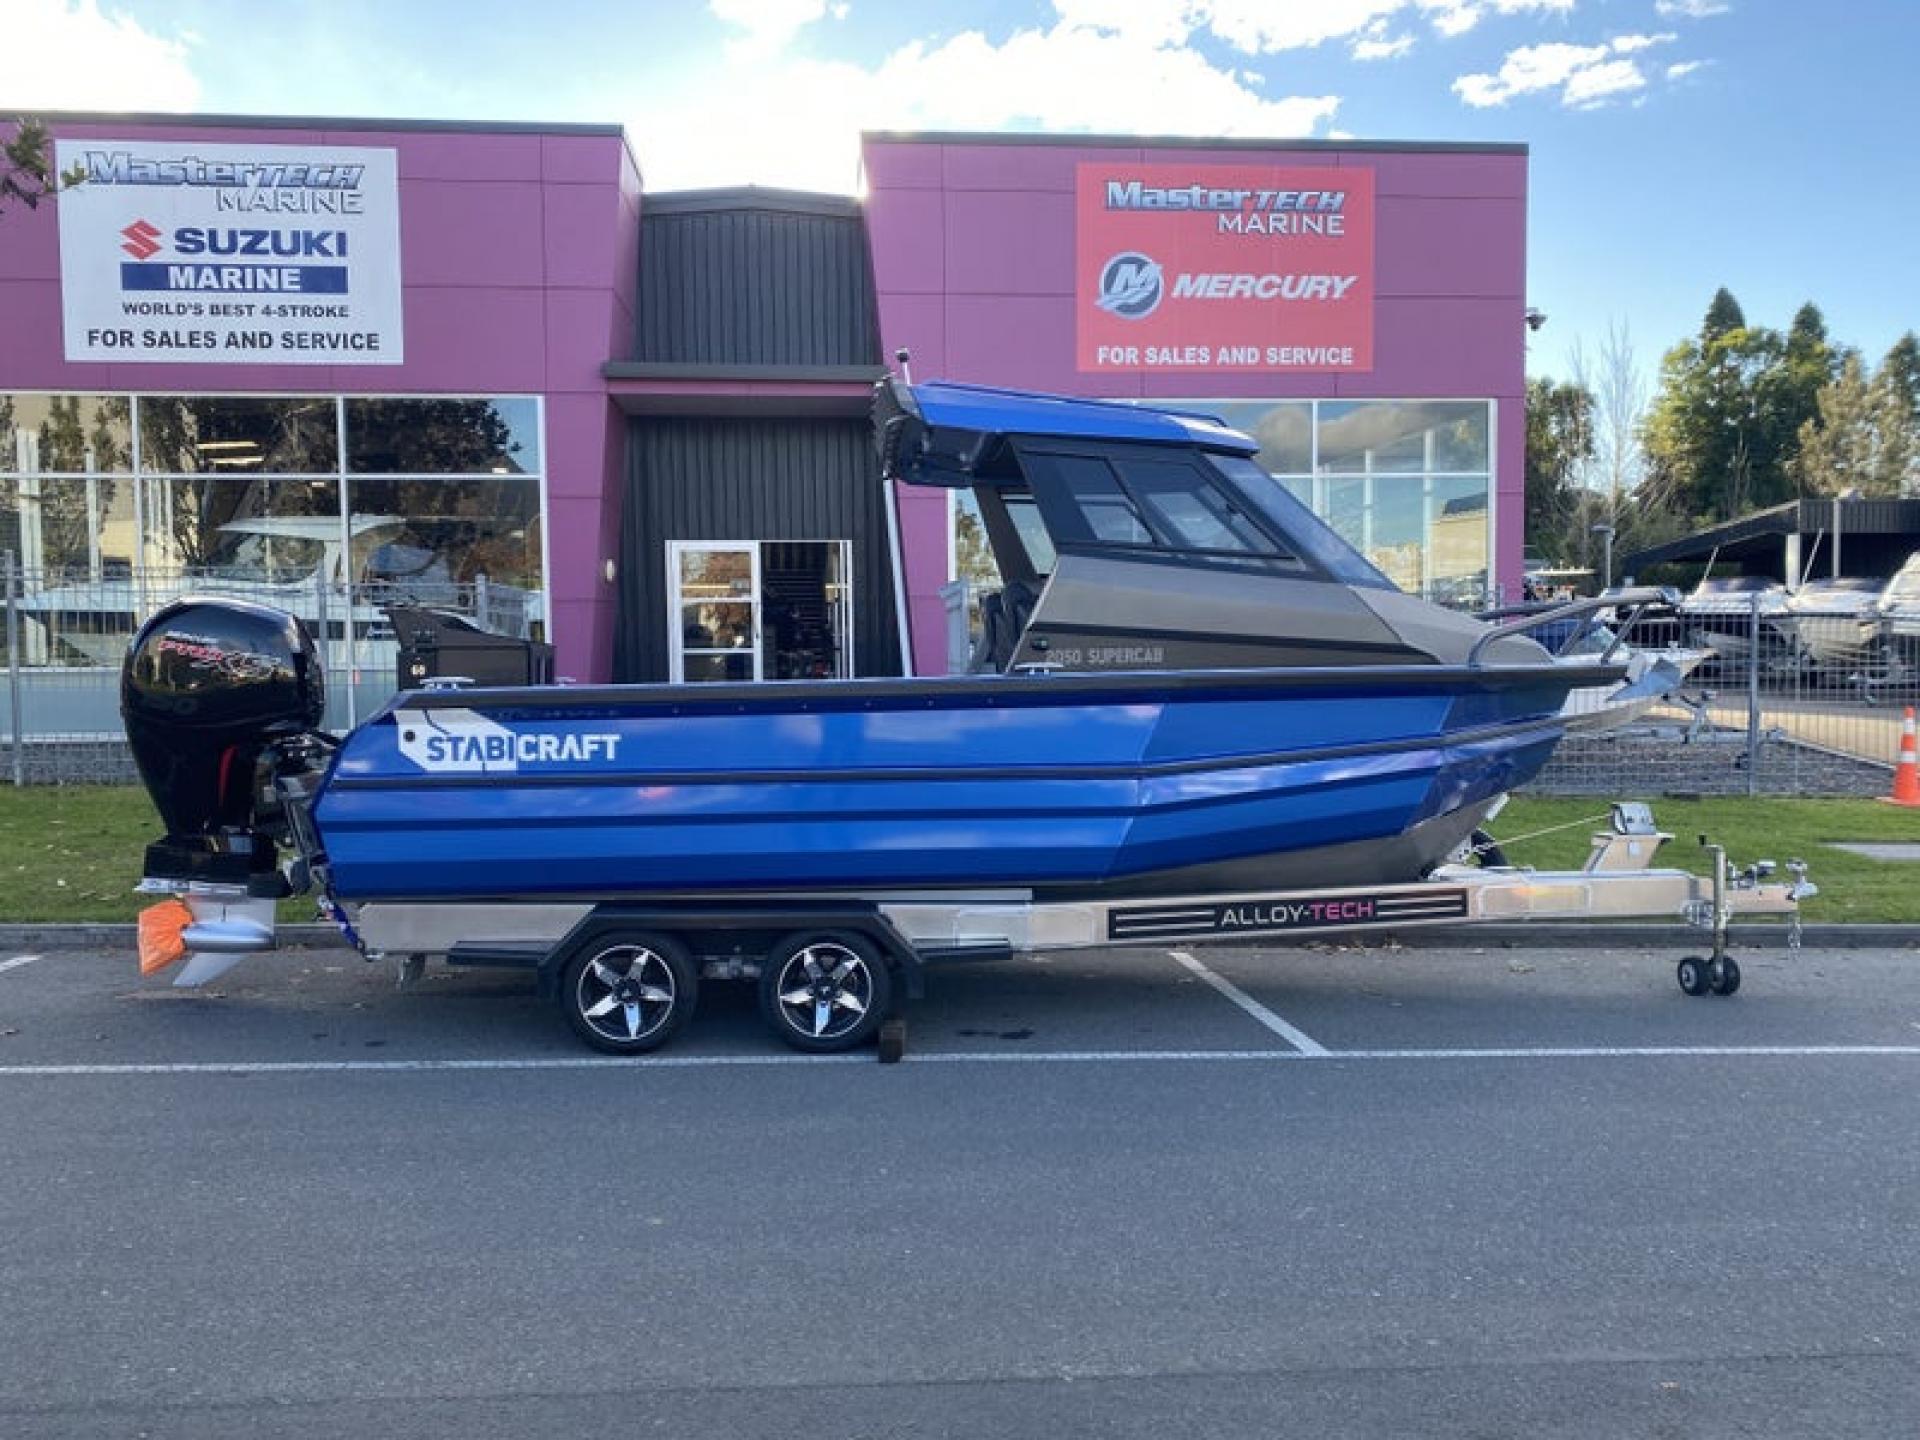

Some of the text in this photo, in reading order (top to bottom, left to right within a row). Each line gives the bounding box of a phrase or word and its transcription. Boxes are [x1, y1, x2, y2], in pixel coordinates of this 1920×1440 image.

[216, 188, 363, 214] MARINE
[1217, 213, 1346, 235] MARINE
[174, 227, 347, 257] SUZUKI
[167, 265, 301, 291] MARINE
[1171, 273, 1358, 299] MERCURY
[122, 302, 349, 318] WORLD'S BEST 4-STROKE
[88, 329, 380, 351] FOR SALES AND SERVICE
[1097, 346, 1354, 366] FOR SALES AND SERVICE
[1088, 648, 1164, 664] SUPERCAB
[427, 735, 620, 761] STABICRAFT
